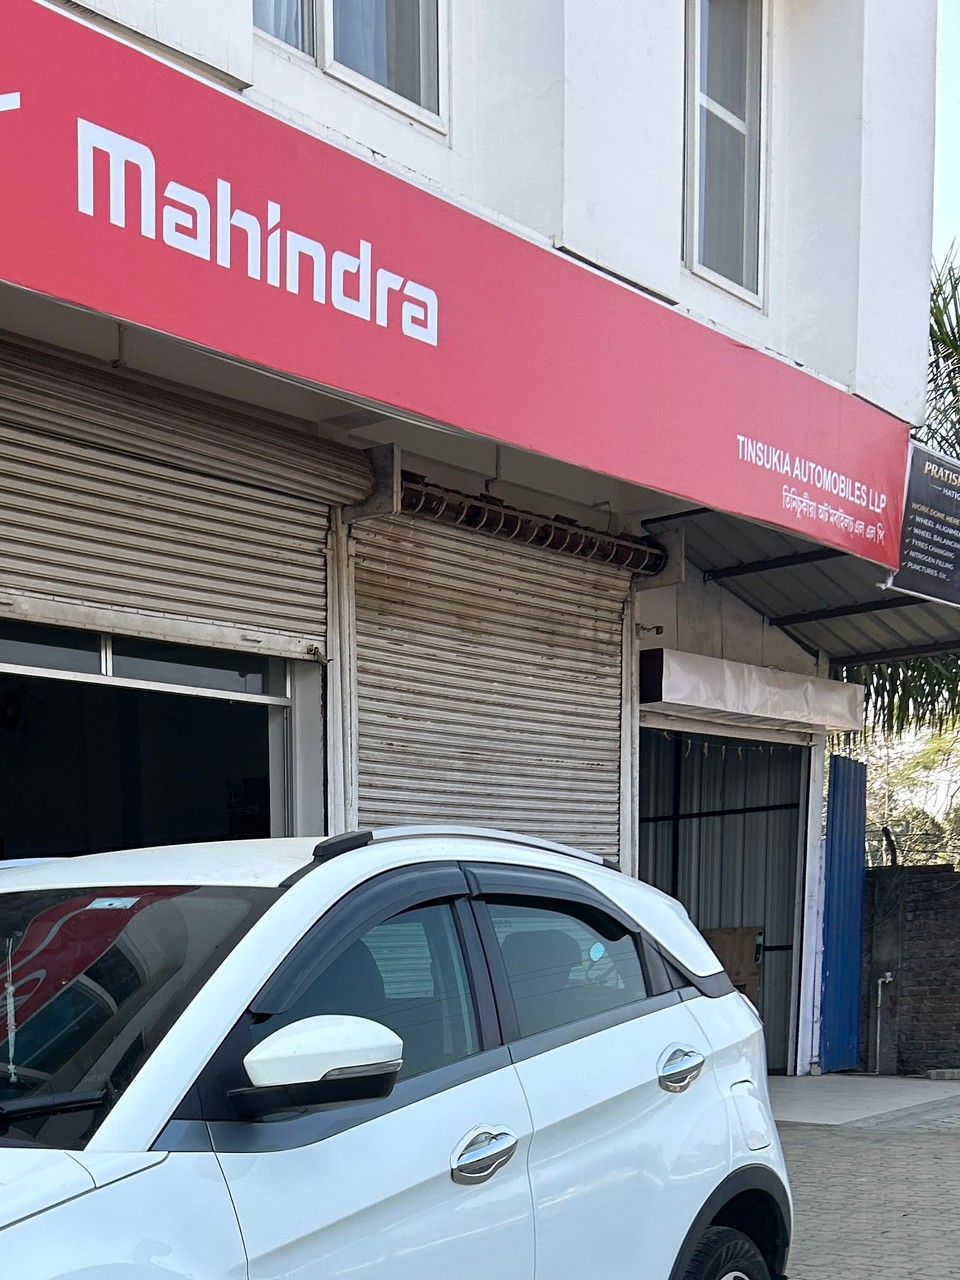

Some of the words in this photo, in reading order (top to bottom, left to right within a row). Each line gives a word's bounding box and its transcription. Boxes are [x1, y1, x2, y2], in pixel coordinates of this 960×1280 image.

[77, 117, 438, 347] Mahindra
[737, 434, 791, 477] TINSUKIA
[793, 456, 868, 507] AUTOMOBILES
[869, 488, 887, 514] LLP
[911, 501, 930, 514] WORK
[929, 508, 946, 520] DONE
[915, 515, 935, 528] WHEEL
[913, 526, 933, 540] WHEEL
[911, 538, 929, 550] TYRES
